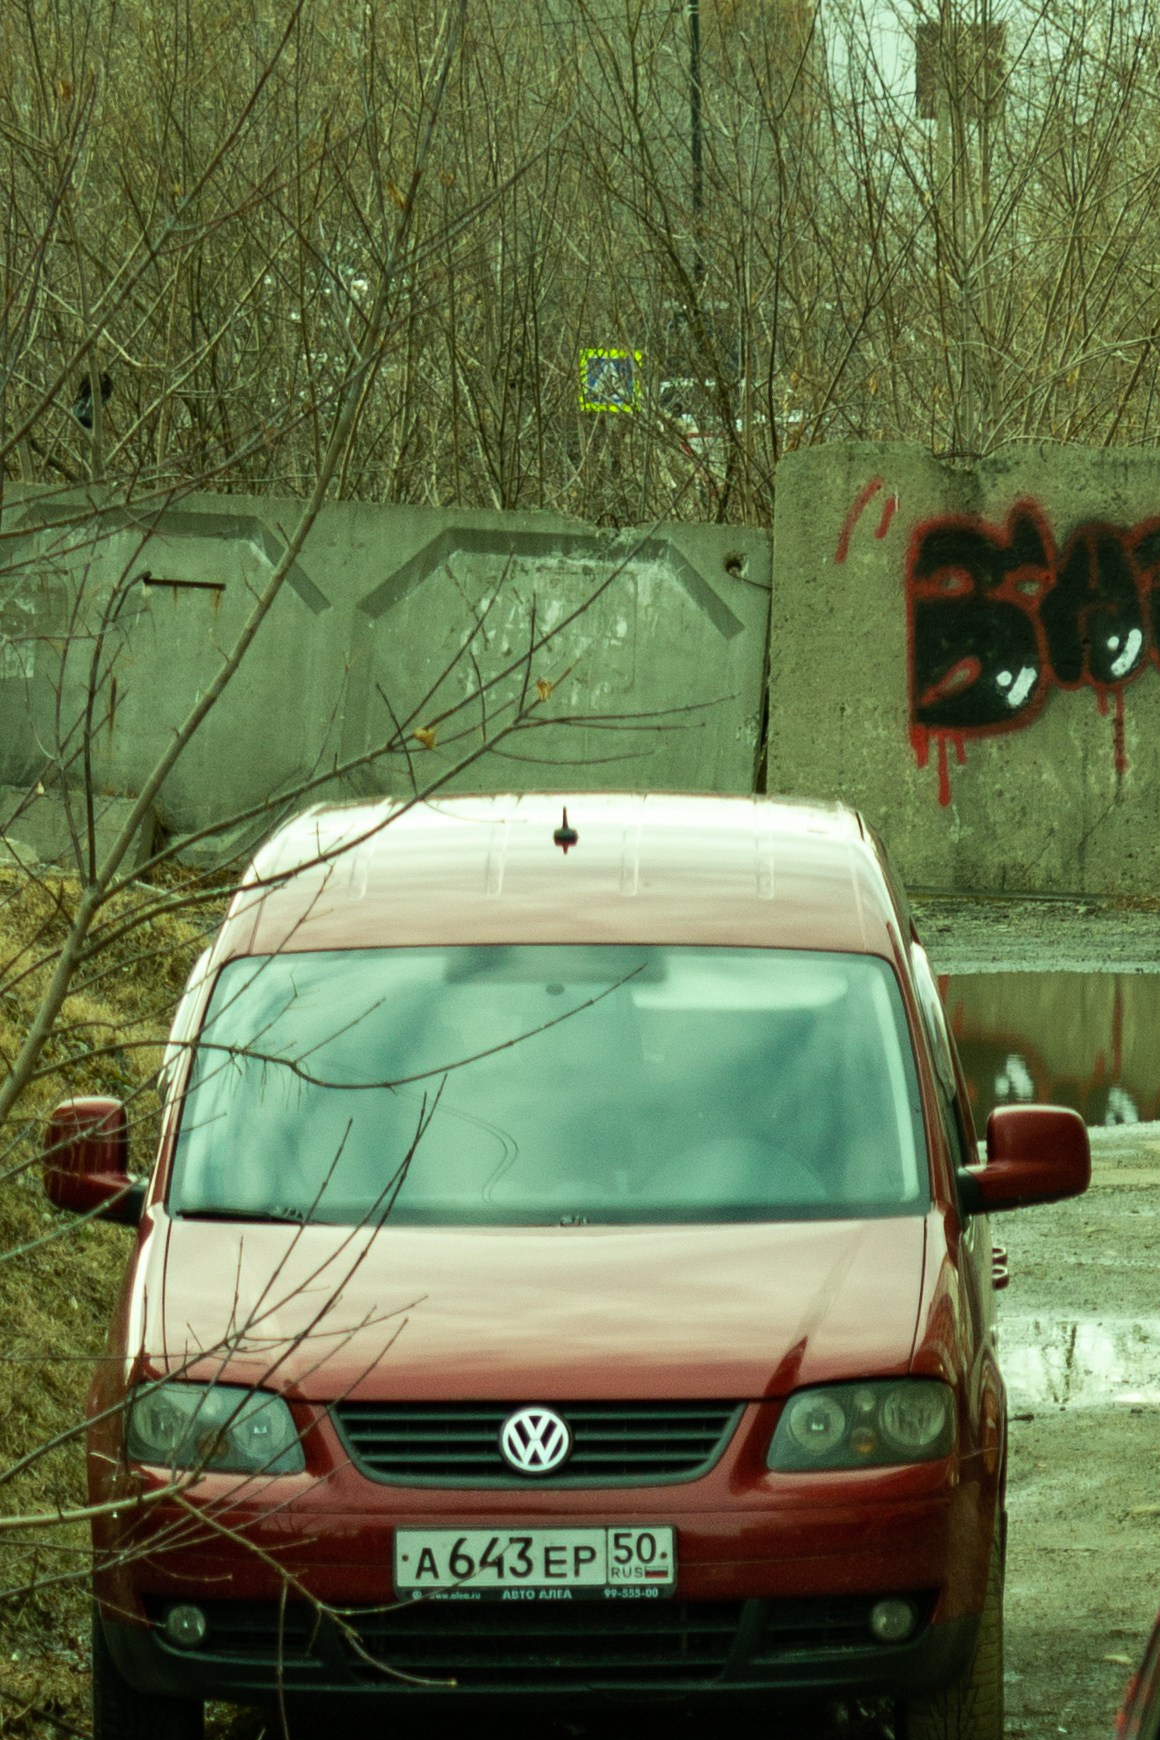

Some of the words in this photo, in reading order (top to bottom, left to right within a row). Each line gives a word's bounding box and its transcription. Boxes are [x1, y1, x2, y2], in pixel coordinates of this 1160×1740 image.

[613, 1532, 657, 1565] 50
[611, 1566, 643, 1579] RUS
[502, 1588, 536, 1600] АВТО
